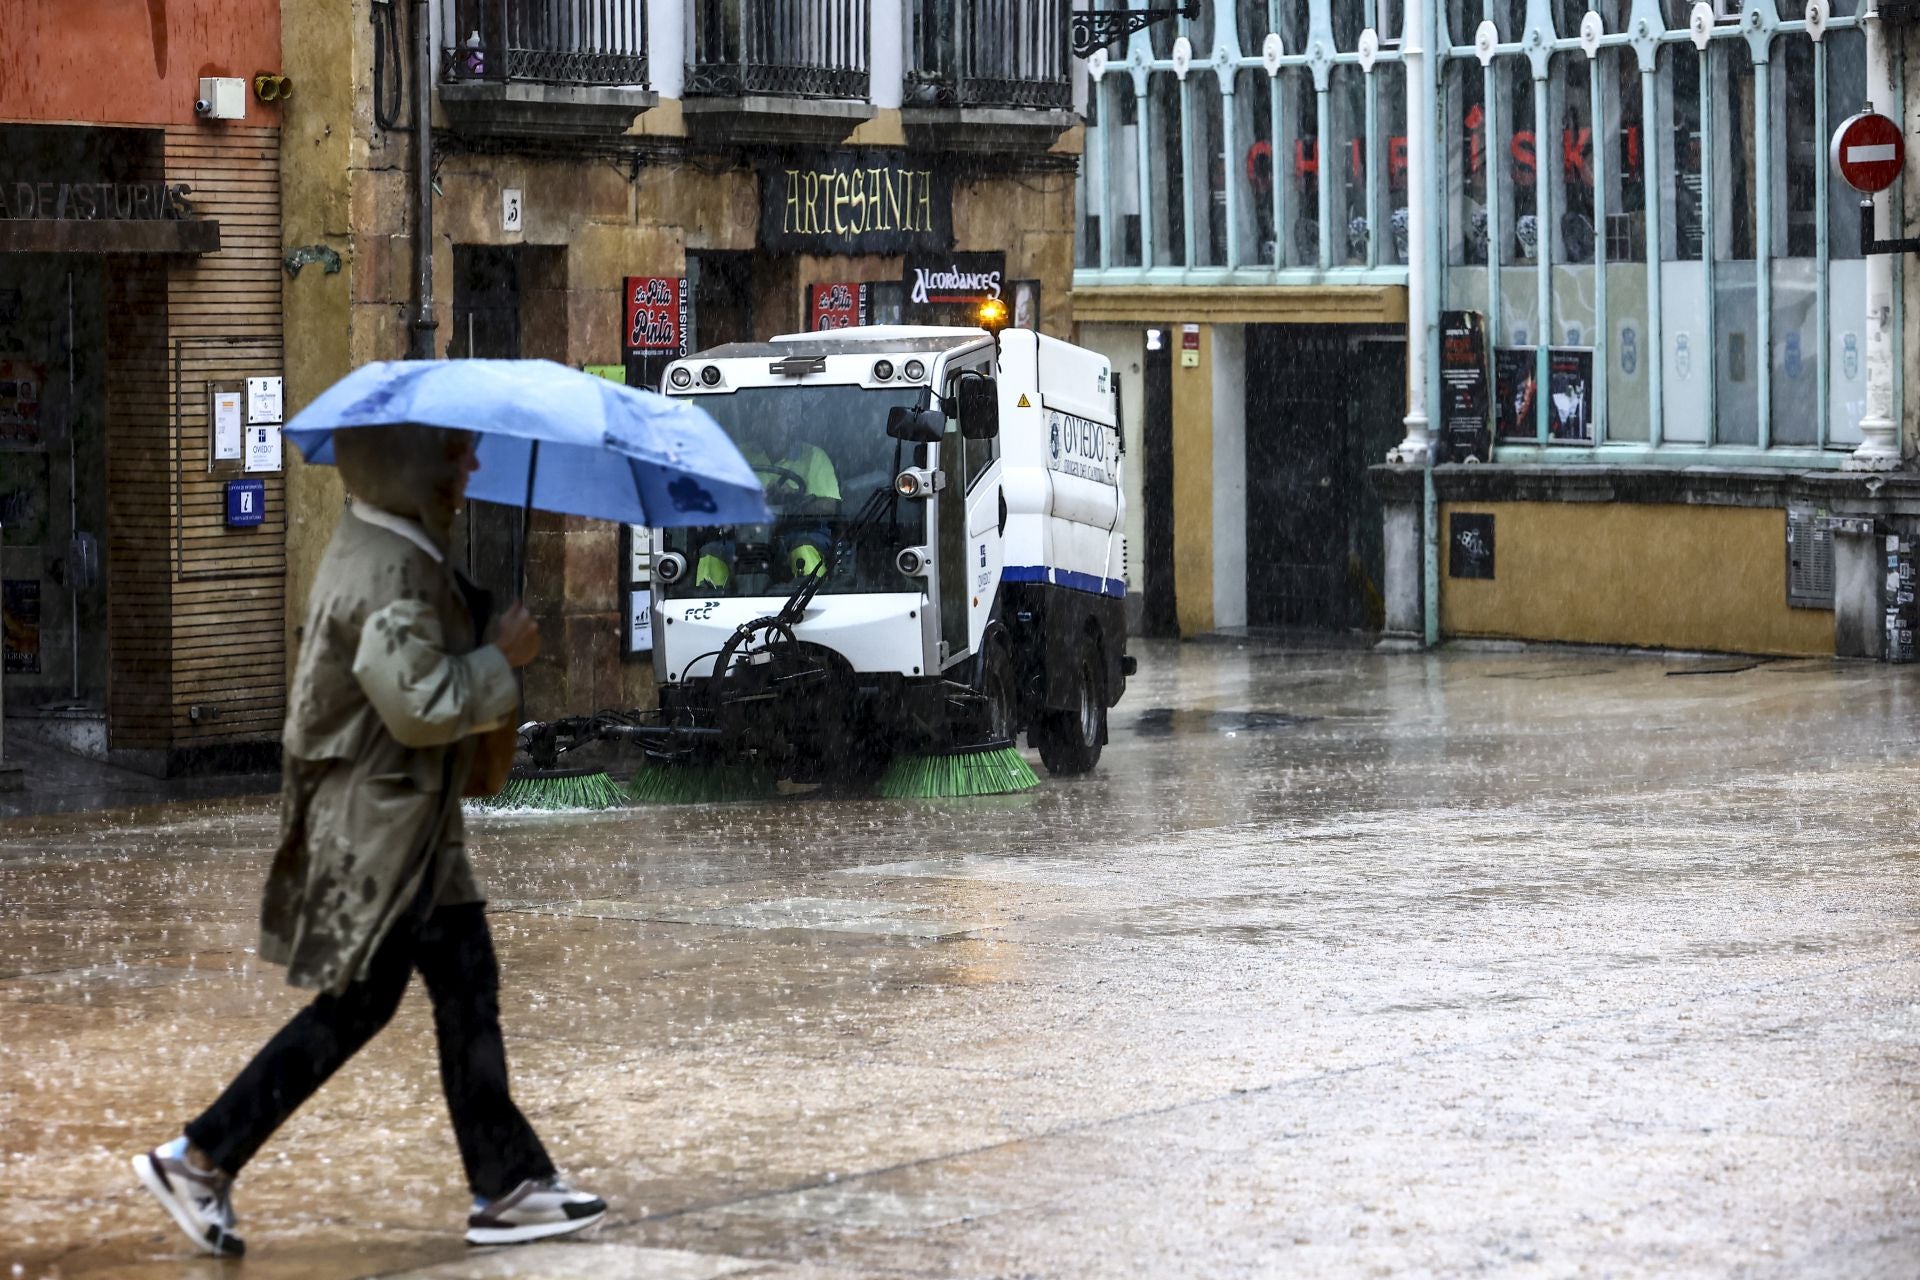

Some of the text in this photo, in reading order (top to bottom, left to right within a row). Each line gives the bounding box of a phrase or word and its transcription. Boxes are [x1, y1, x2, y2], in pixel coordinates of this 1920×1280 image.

[16, 182, 53, 219] DE
[56, 183, 193, 219] ASTURIAS
[784, 168, 932, 237] ARTESANIA
[634, 279, 673, 306] La Pita
[829, 285, 852, 311] Pita
[632, 309, 674, 345] Pinta
[679, 279, 687, 357] CAMISETES
[252, 445, 272, 454] OVIEDO
[1064, 415, 1104, 463] OVIEDO
[685, 607, 713, 621] FCC
